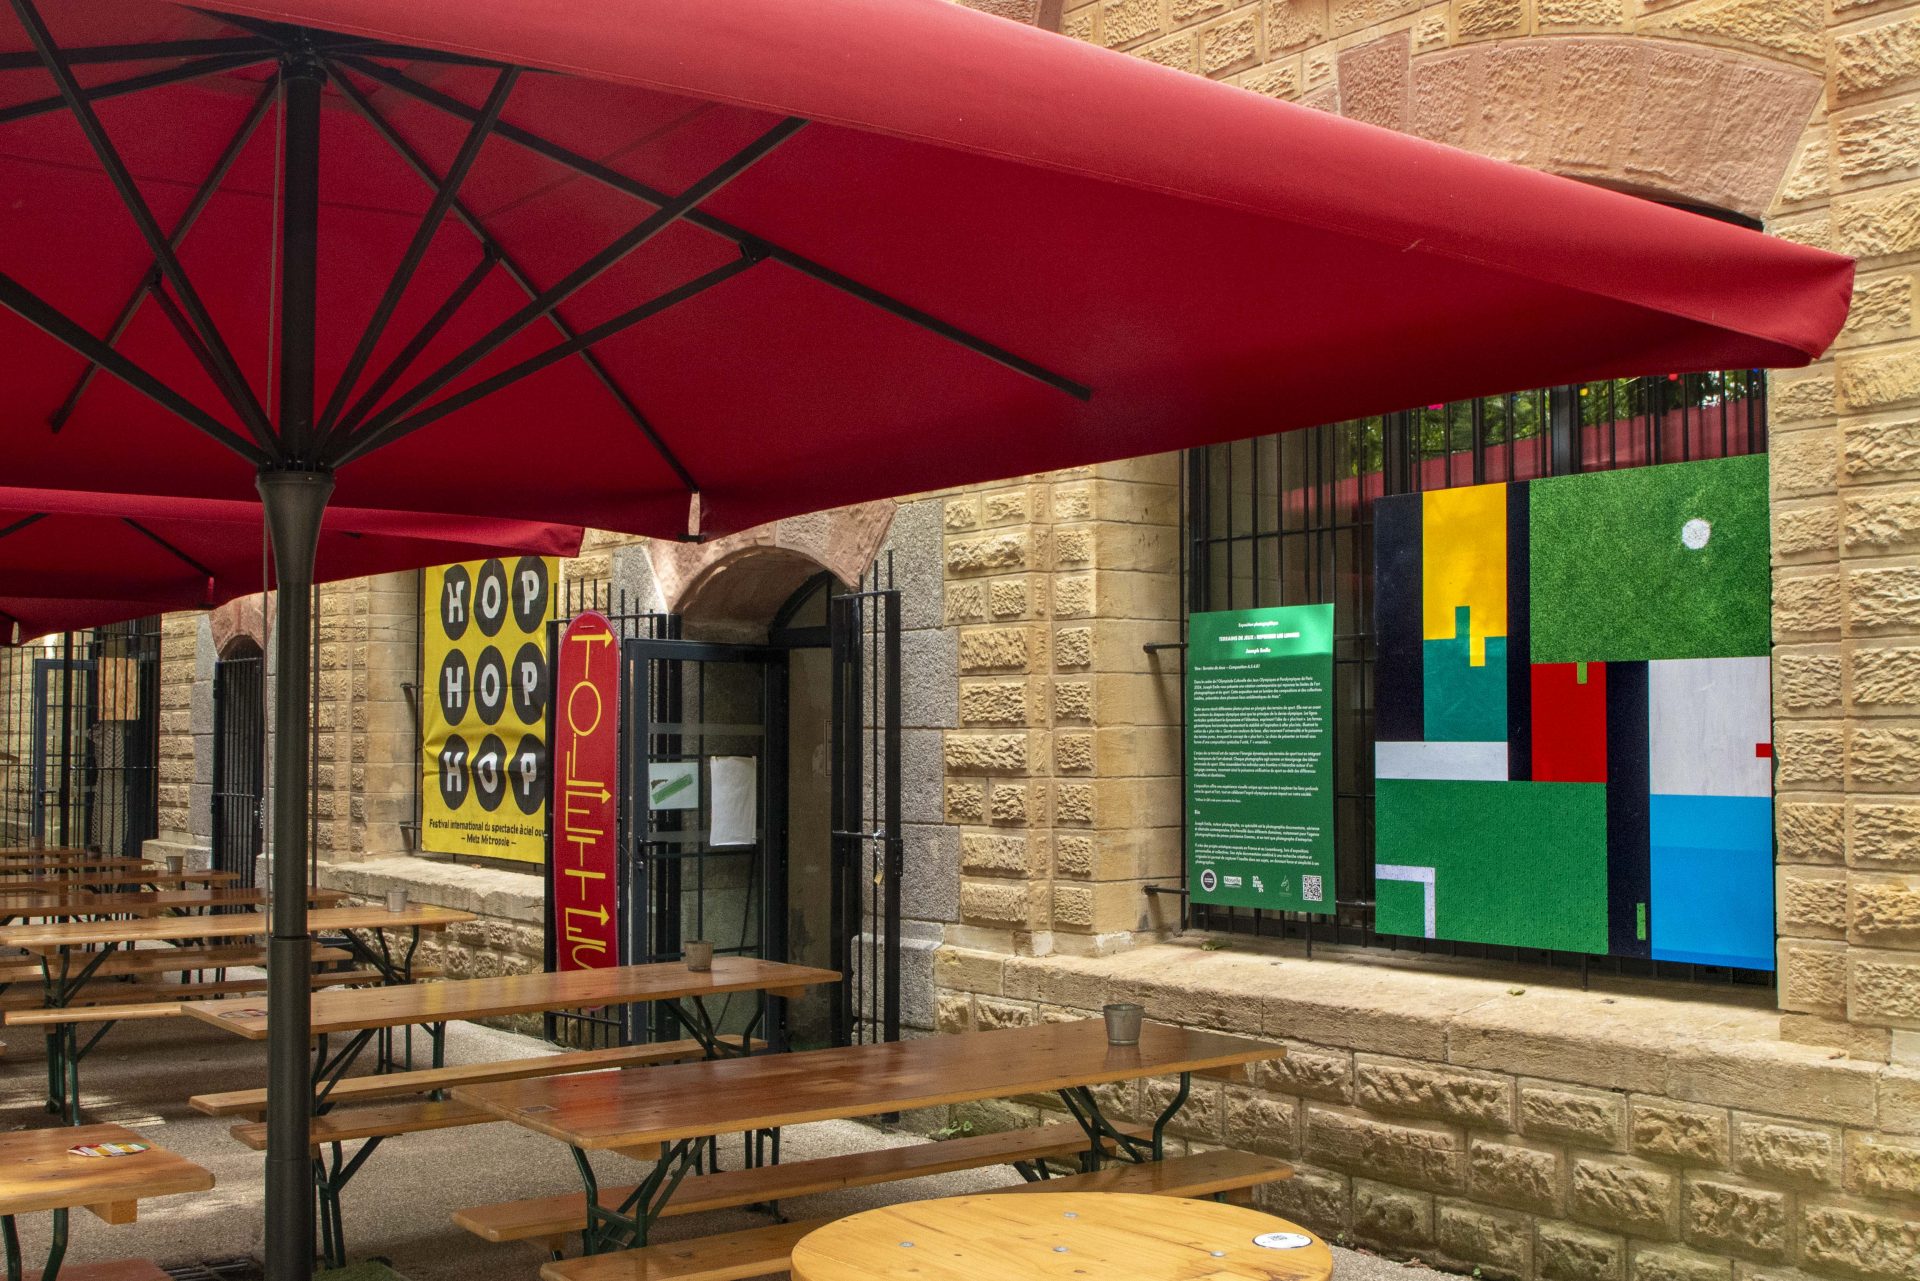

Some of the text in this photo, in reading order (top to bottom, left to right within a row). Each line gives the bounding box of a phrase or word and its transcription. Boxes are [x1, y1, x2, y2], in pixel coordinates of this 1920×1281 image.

[447, 570, 540, 623] HOP
[445, 661, 538, 708] HOP
[443, 751, 537, 796] HOP
[430, 818, 450, 829] Festival
[450, 820, 484, 831] international
[492, 824, 518, 835] spectacle
[467, 834, 480, 844] Metz
